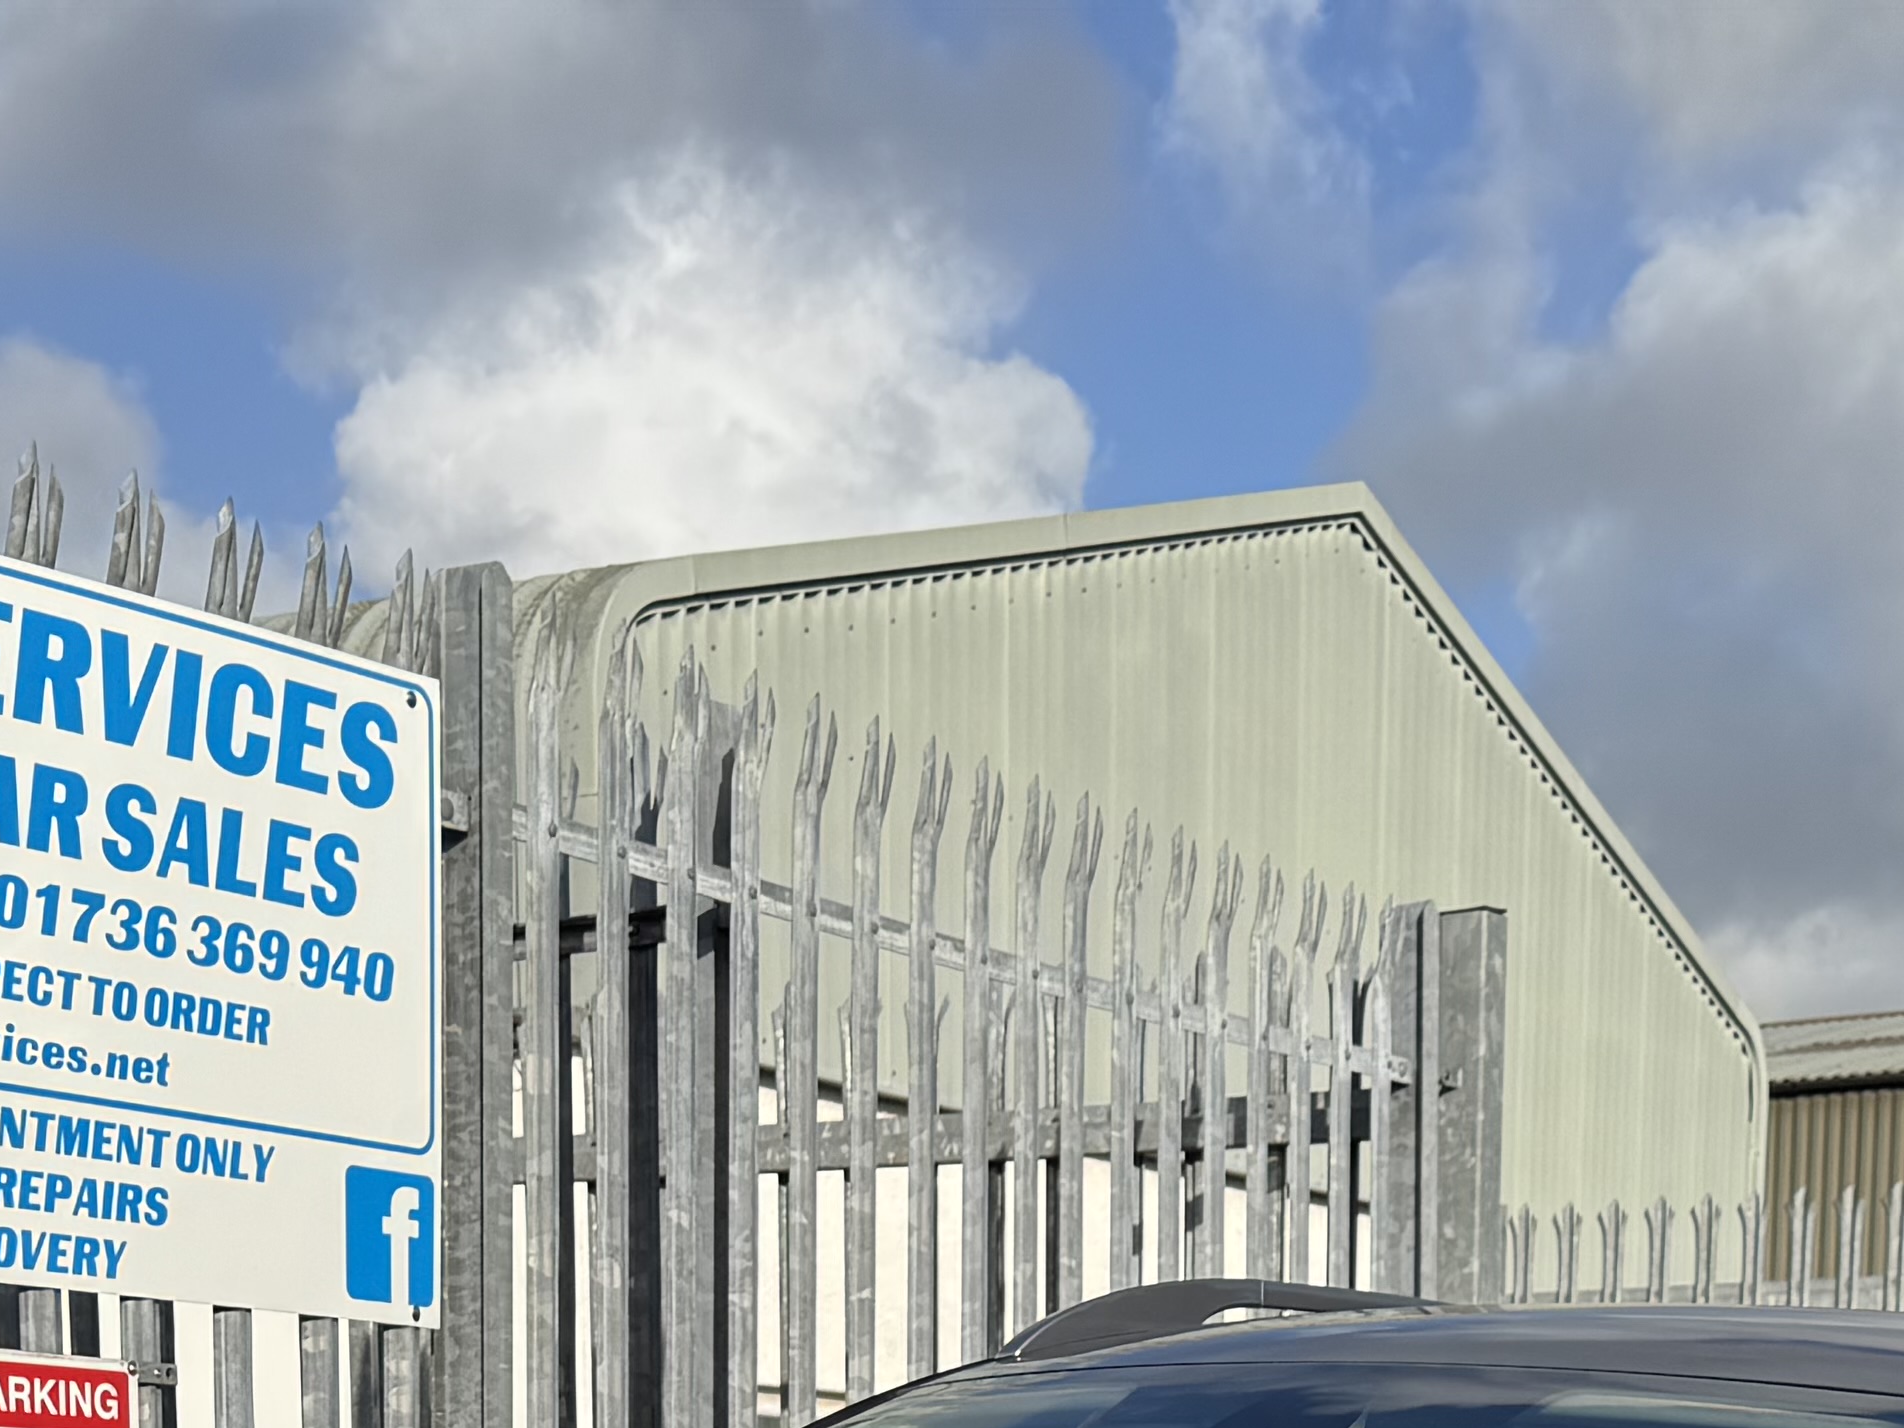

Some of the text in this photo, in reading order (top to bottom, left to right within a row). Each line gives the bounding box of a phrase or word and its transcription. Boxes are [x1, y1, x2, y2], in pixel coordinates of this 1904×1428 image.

[102, 783, 360, 918] SALES
[188, 915, 291, 982] 369
[300, 938, 395, 1003] 940
[89, 977, 139, 1022] TO
[144, 987, 271, 1046] ORDER
[175, 1132, 276, 1184] ONLY
